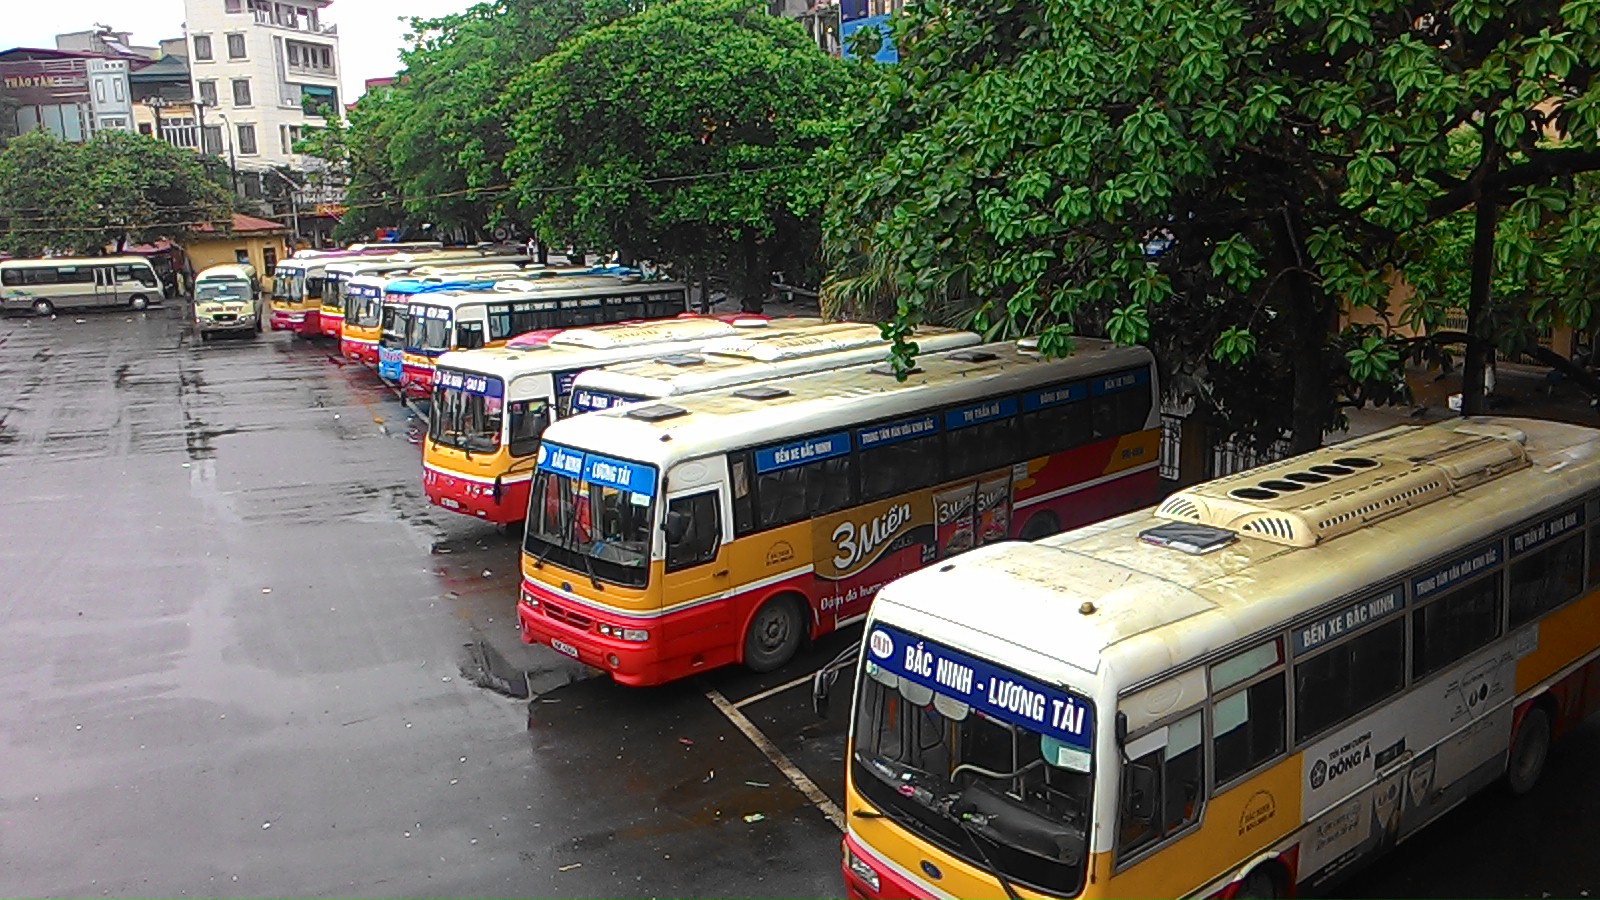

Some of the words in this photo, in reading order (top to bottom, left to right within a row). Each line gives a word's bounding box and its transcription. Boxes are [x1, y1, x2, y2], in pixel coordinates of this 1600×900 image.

[775, 446, 789, 464] BẾN
[791, 448, 800, 460] XE
[801, 442, 814, 459] BẮC
[815, 441, 832, 454] NINH
[1416, 577, 1435, 595] TRUNG
[1303, 625, 1326, 647] BẾN
[1328, 615, 1343, 636] XE
[1346, 604, 1368, 629] BẮC
[1369, 593, 1395, 619] NINH
[905, 641, 933, 678] BẮC
[936, 657, 974, 695] NINH
[988, 677, 1046, 722] LƯƠNG
[1052, 696, 1085, 735] TÀI
[1328, 754, 1362, 779] ĐÔNG
[1362, 741, 1371, 761] Á
